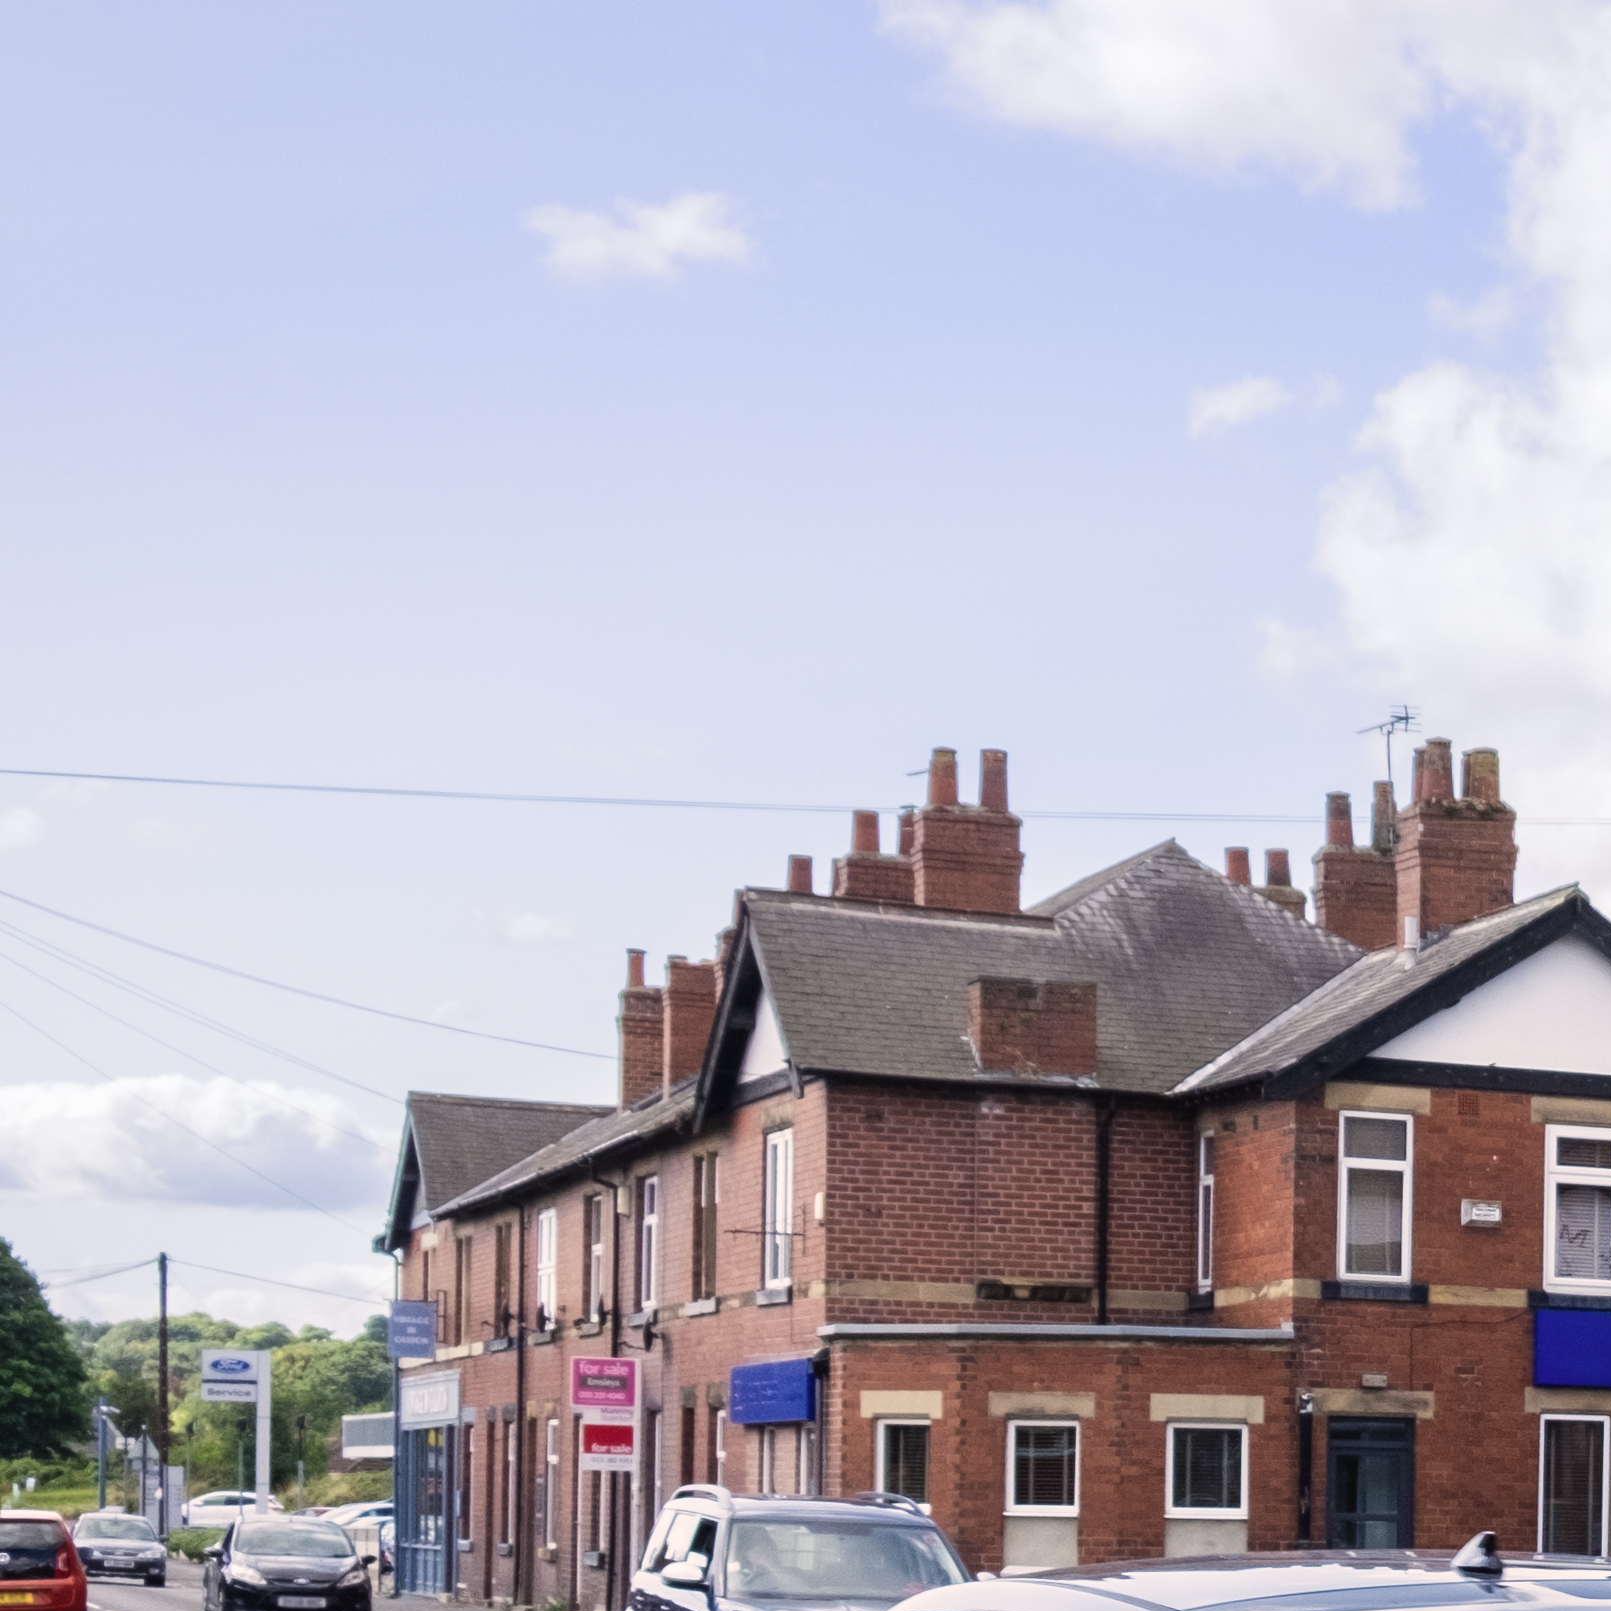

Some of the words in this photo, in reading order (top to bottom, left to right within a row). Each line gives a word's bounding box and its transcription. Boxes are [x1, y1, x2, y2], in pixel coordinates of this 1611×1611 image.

[579, 1361, 600, 1375] for
[603, 1362, 628, 1375] sale
[610, 1443, 632, 1453] sale
